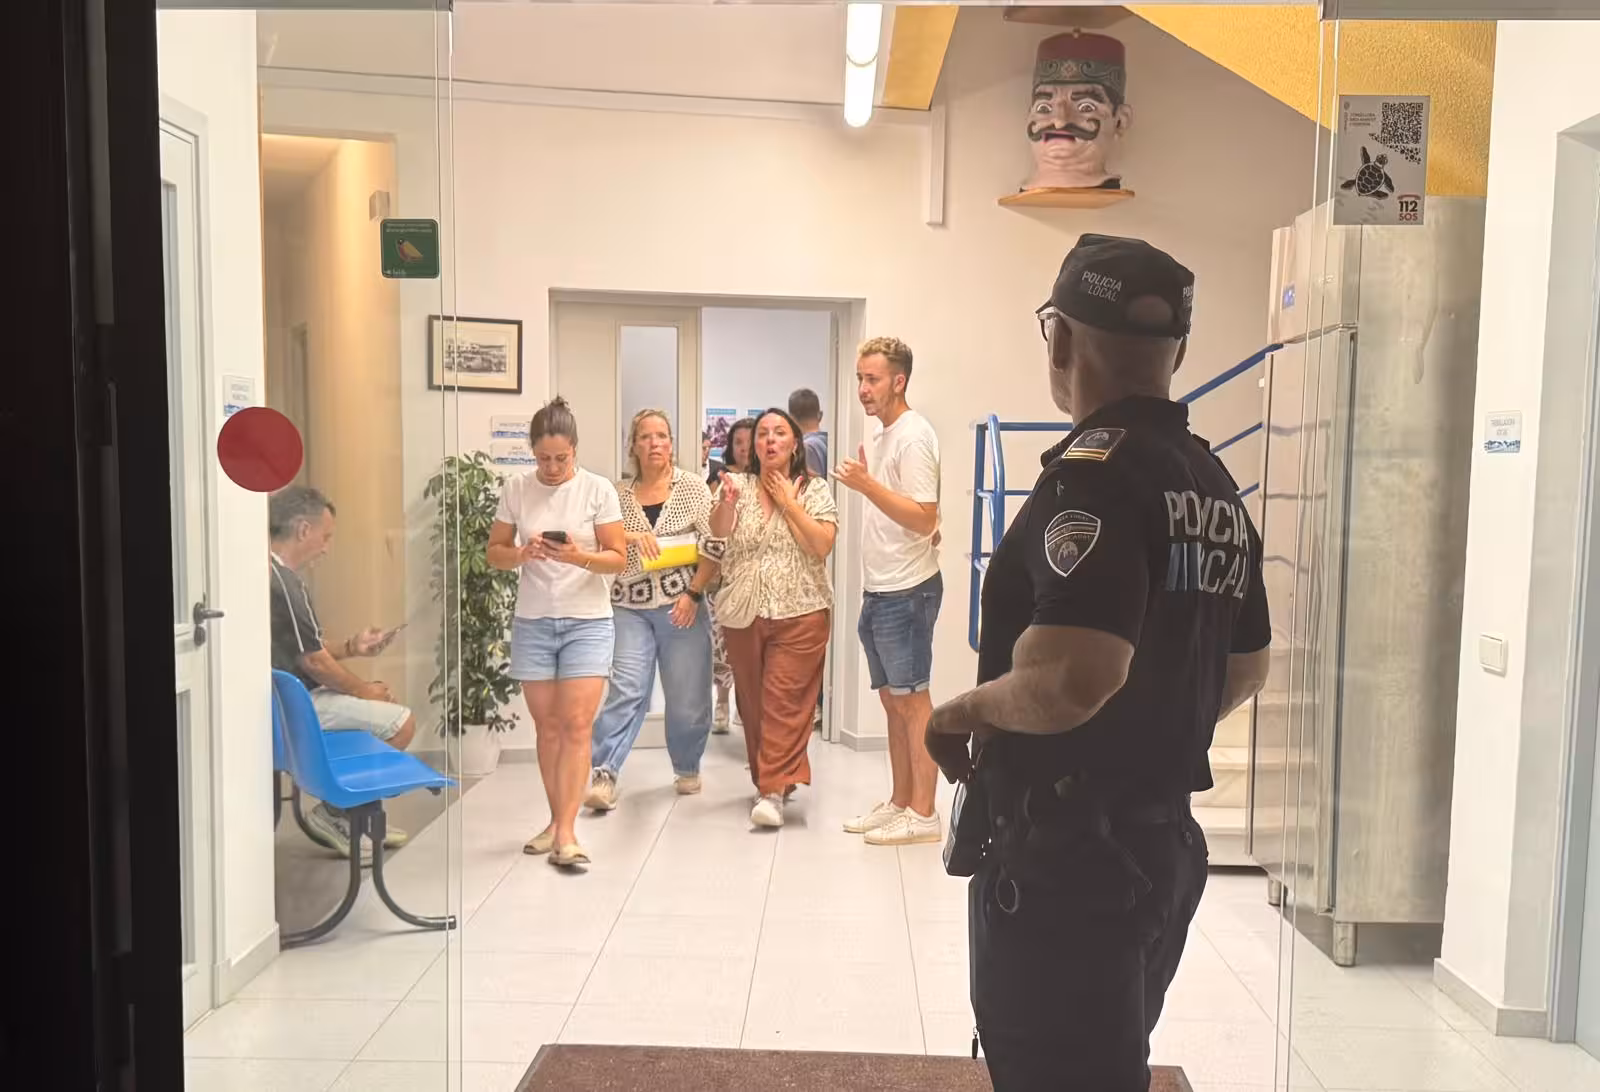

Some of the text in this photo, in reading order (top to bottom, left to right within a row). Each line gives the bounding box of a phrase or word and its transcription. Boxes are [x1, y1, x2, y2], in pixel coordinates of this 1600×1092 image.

[1399, 200, 1418, 213] 112
[1399, 212, 1418, 221] SOS
[1082, 271, 1122, 292] POLICIA
[1088, 285, 1119, 302] LOCAL
[1164, 490, 1249, 552] POICIA
